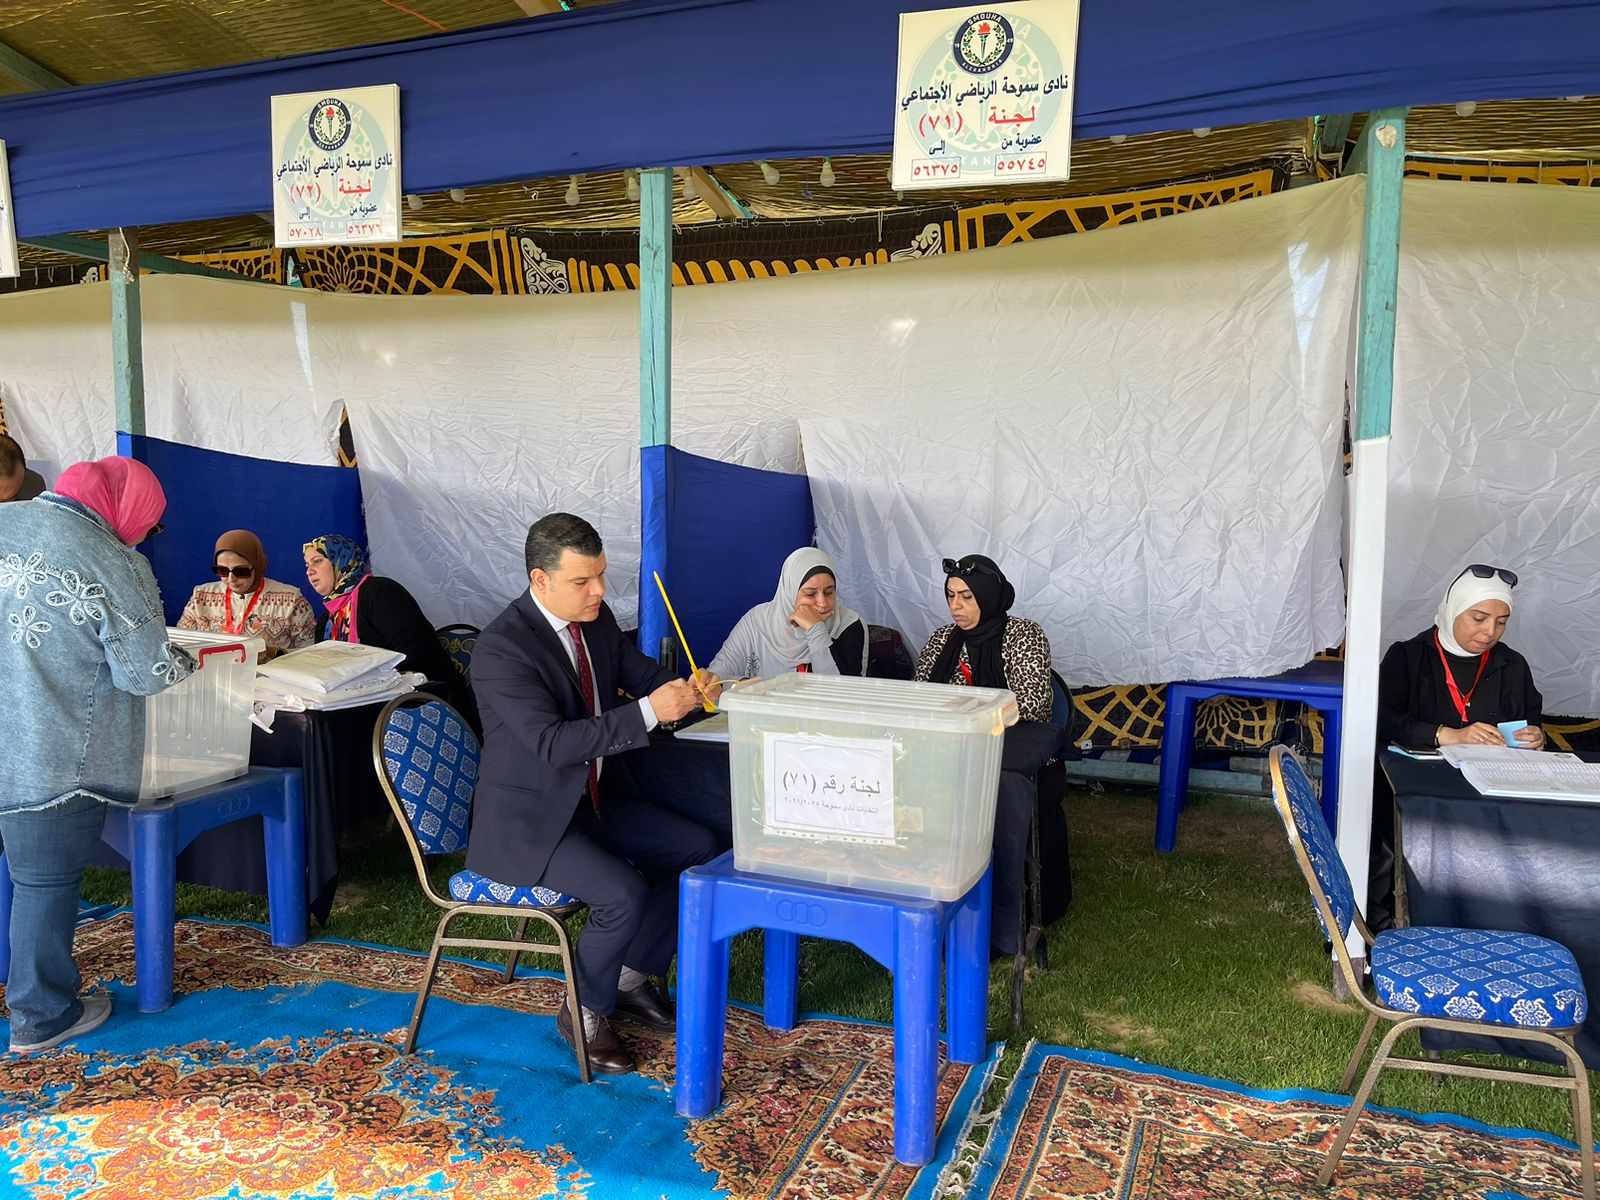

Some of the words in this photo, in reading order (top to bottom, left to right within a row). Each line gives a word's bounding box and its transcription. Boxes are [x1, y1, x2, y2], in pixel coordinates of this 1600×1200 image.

[968, 13, 1002, 25] SMOUHA
[955, 80, 997, 106] الرياضي
[1002, 76, 1039, 97] سموحة
[988, 105, 1036, 127] لجنة
[1001, 138, 1013, 150] من
[1015, 133, 1042, 151] عضوية
[314, 157, 343, 178] الرياضي
[346, 154, 372, 172] سموحة
[913, 164, 959, 177] ٥٦٣٧٥
[997, 157, 1046, 171] ٥٥٧٤٥
[338, 178, 372, 197] لجنة
[359, 201, 378, 217] عضوية
[822, 774, 845, 795] رقم
[850, 776, 881, 797] لجنة
